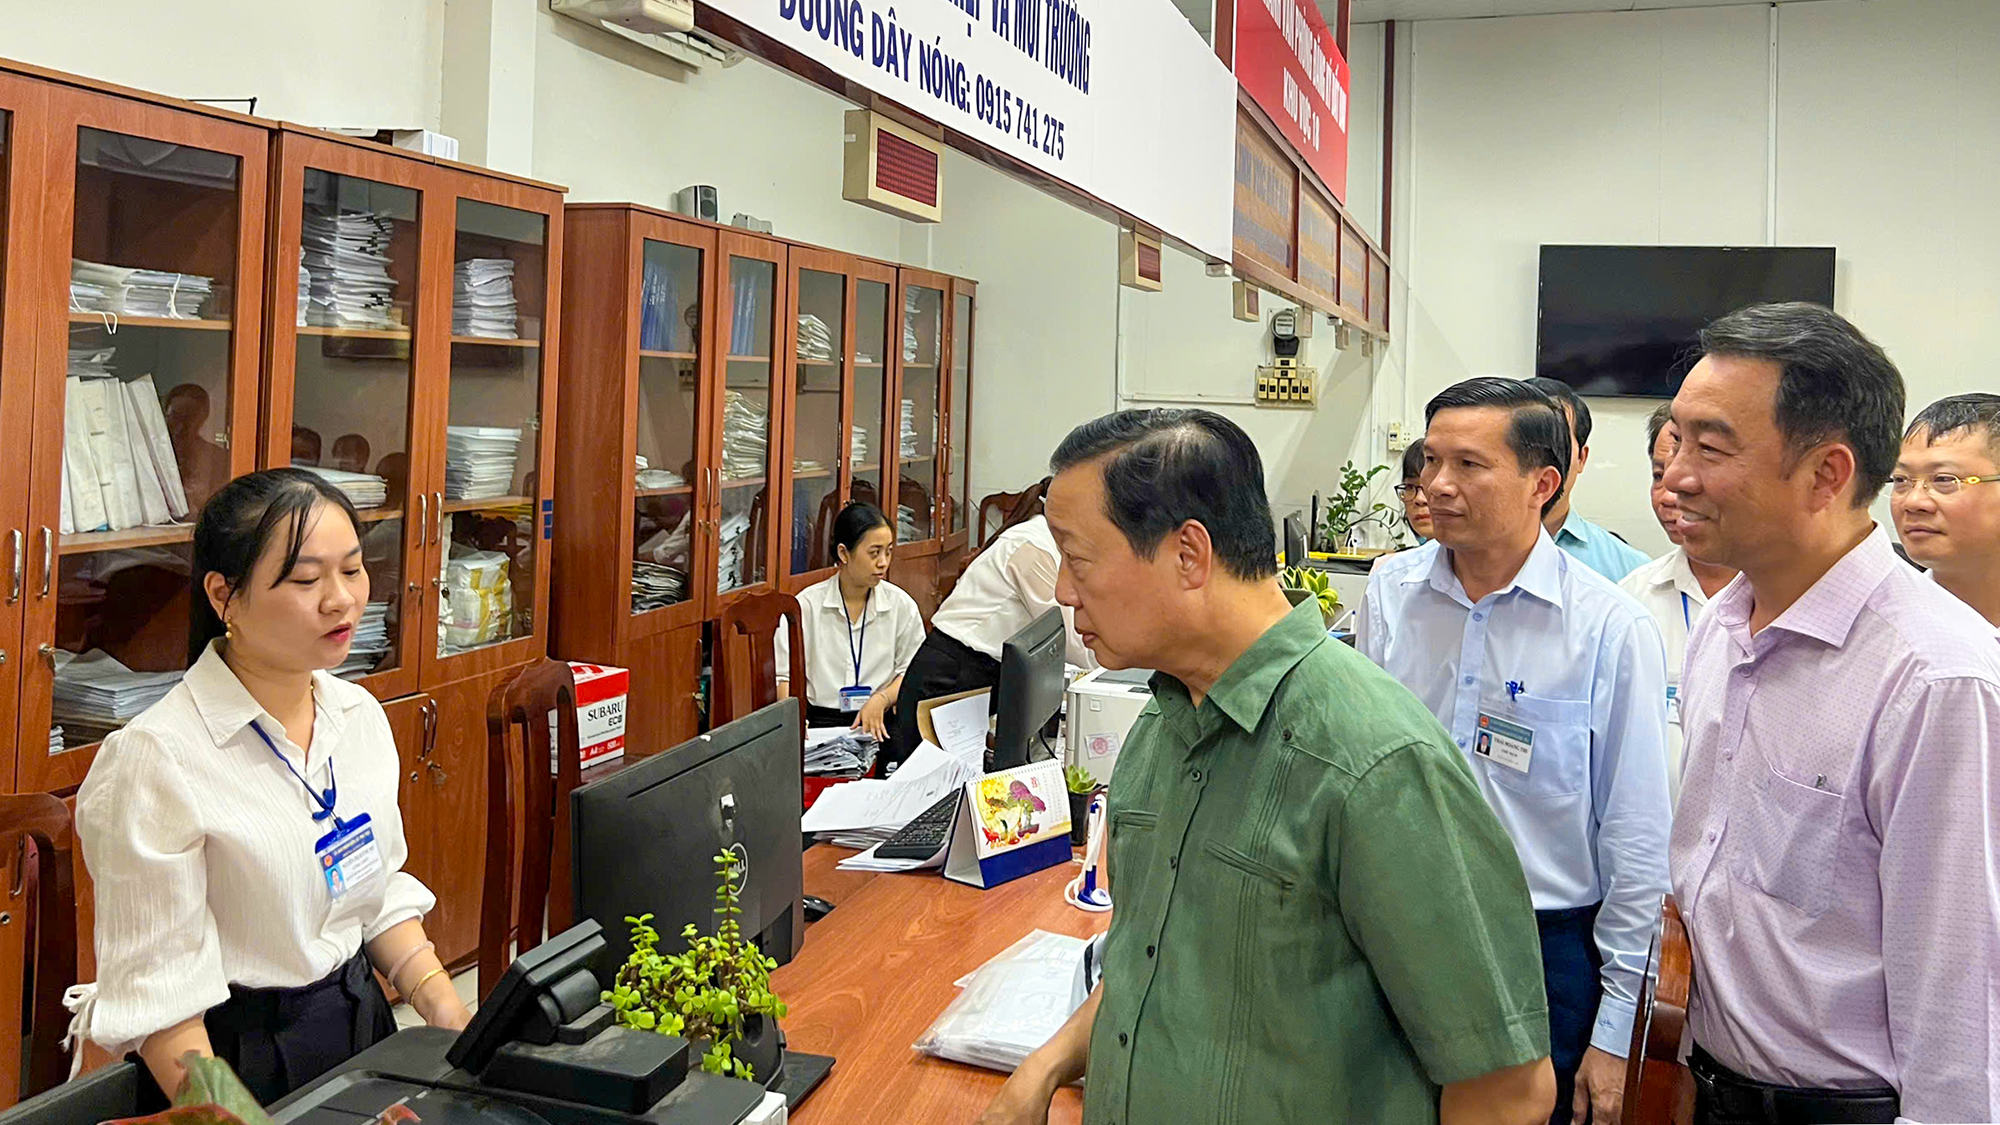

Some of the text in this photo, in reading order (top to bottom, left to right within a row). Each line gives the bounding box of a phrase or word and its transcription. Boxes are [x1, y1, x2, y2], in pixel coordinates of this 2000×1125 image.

[871, 7, 913, 83] DÂY
[919, 36, 971, 114] NÓNG:
[975, 74, 1012, 134] 0915
[1016, 97, 1039, 149] 741
[1043, 114, 1065, 161] 275
[587, 700, 625, 722] SUBARU
